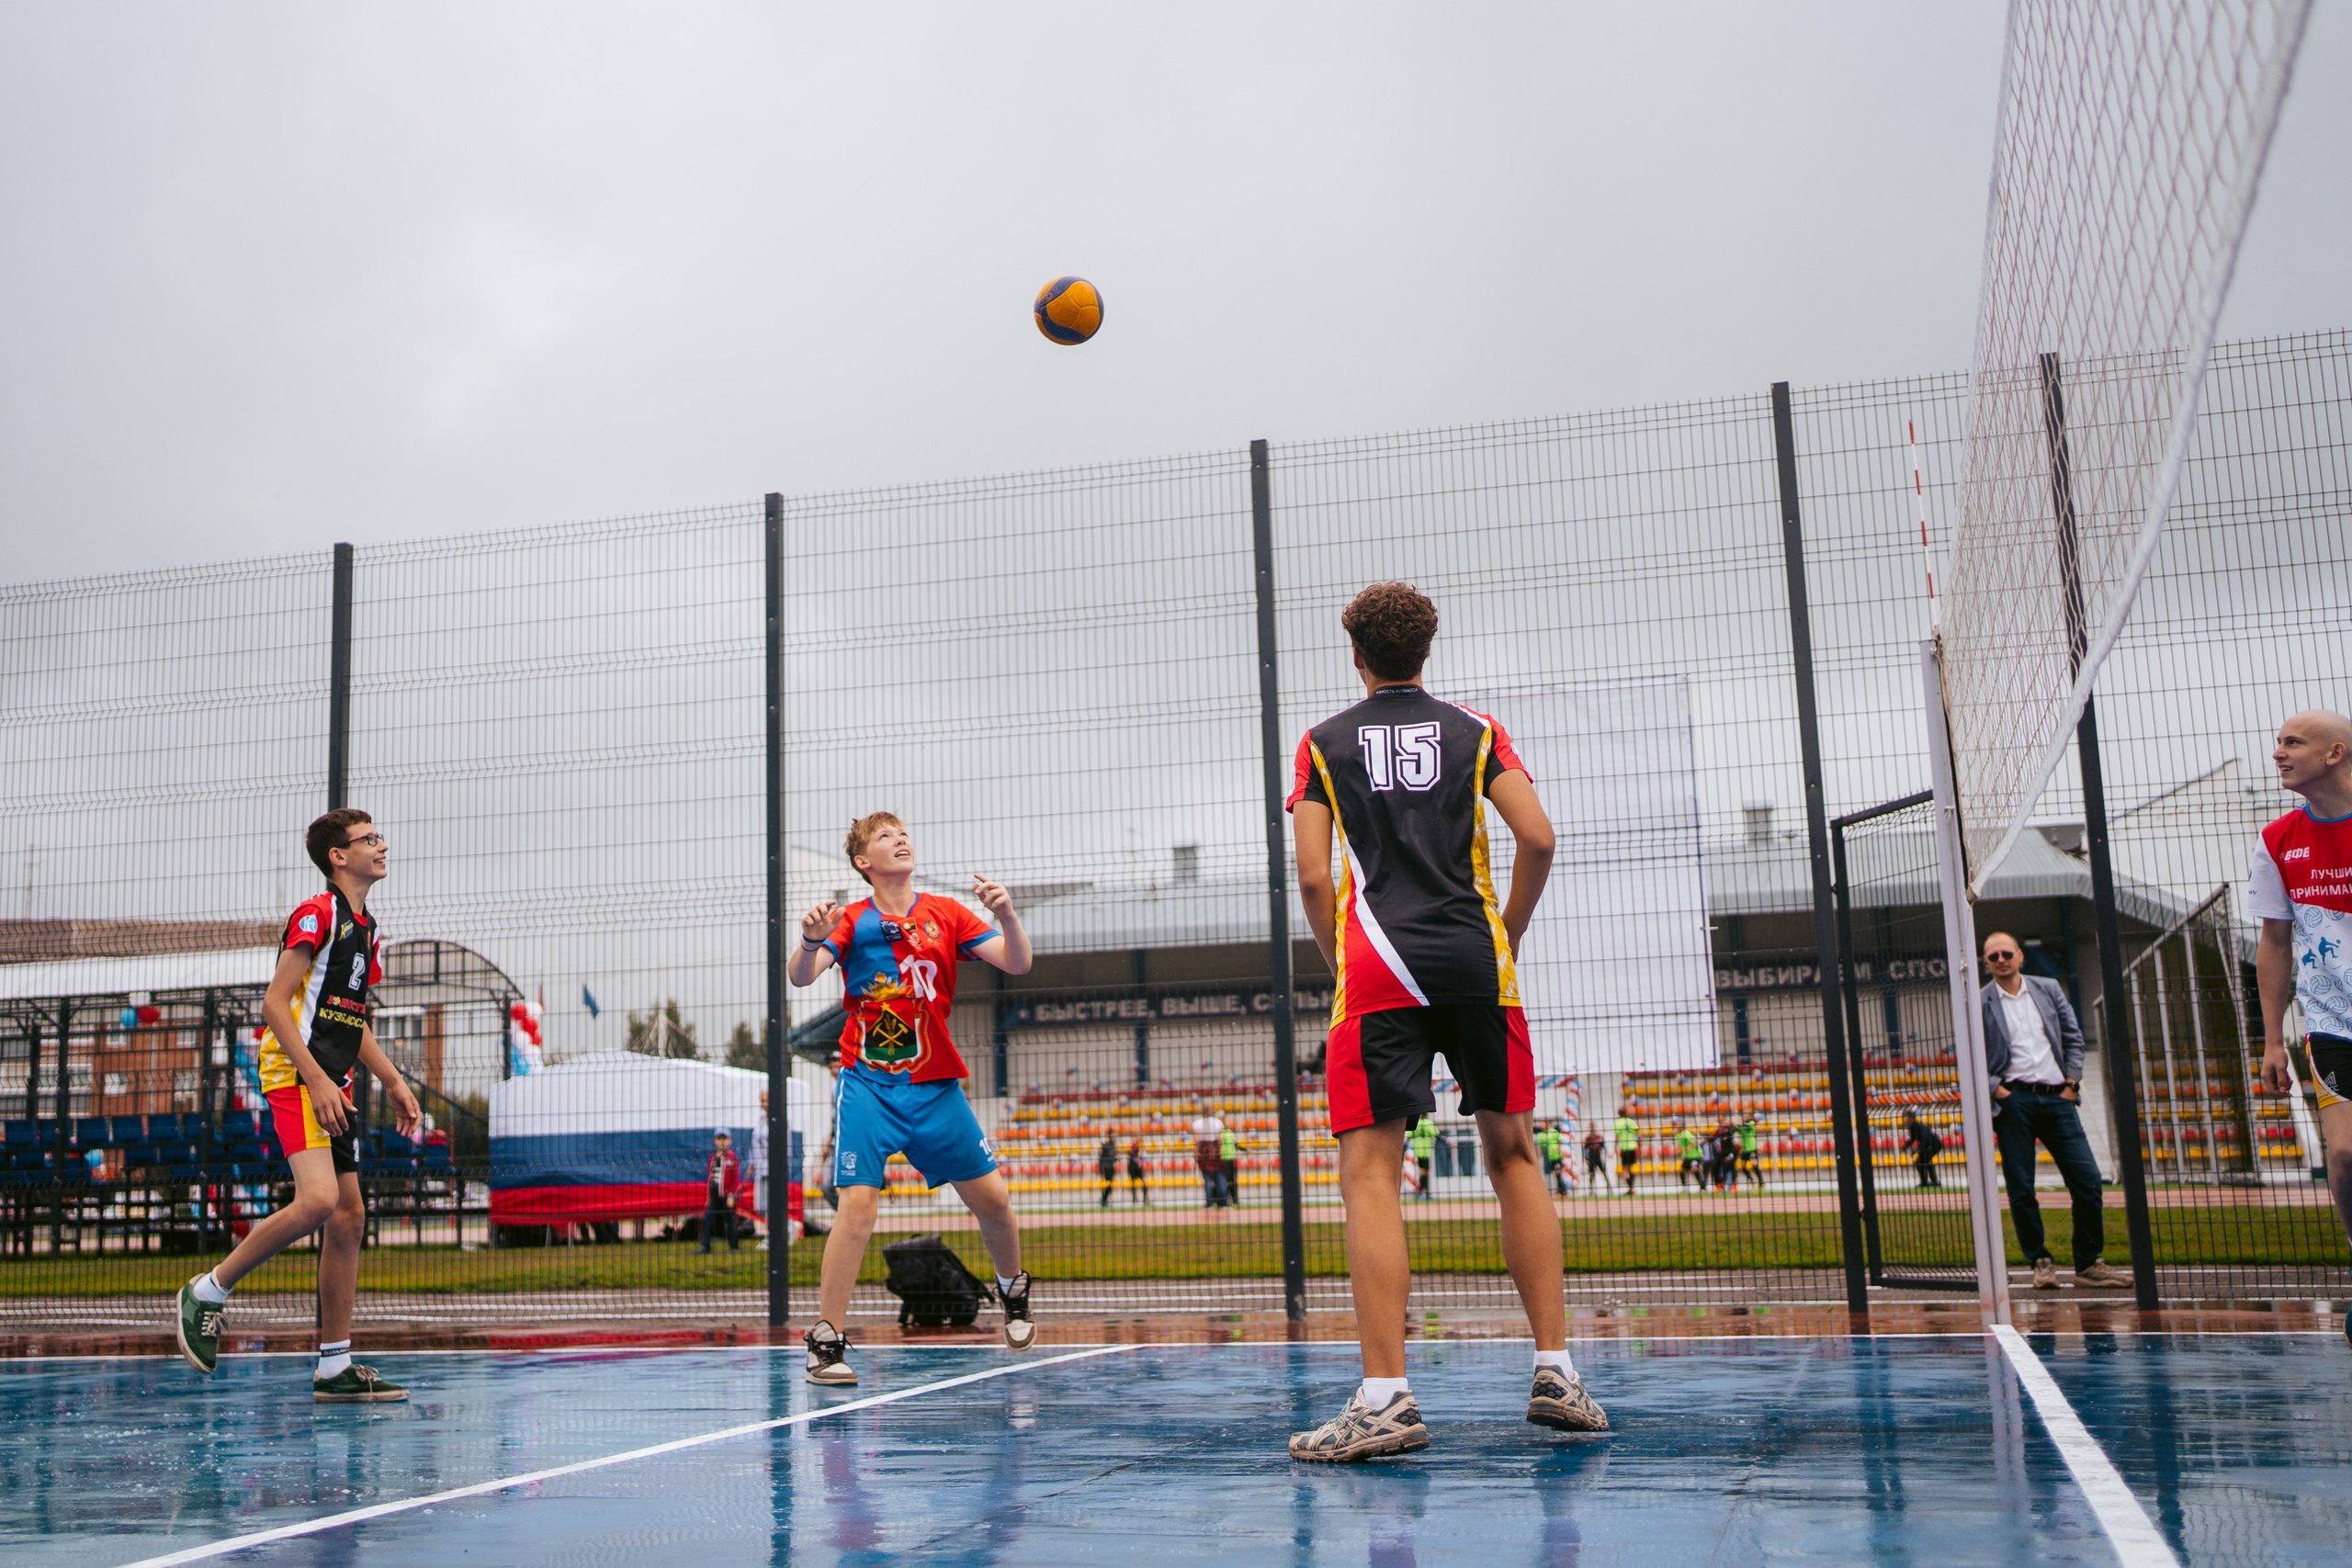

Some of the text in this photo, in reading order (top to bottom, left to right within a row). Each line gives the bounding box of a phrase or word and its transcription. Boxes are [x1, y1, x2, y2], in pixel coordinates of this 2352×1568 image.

[1358, 721, 1441, 792] 15
[348, 952, 366, 991] 2
[899, 954, 937, 1002] 10
